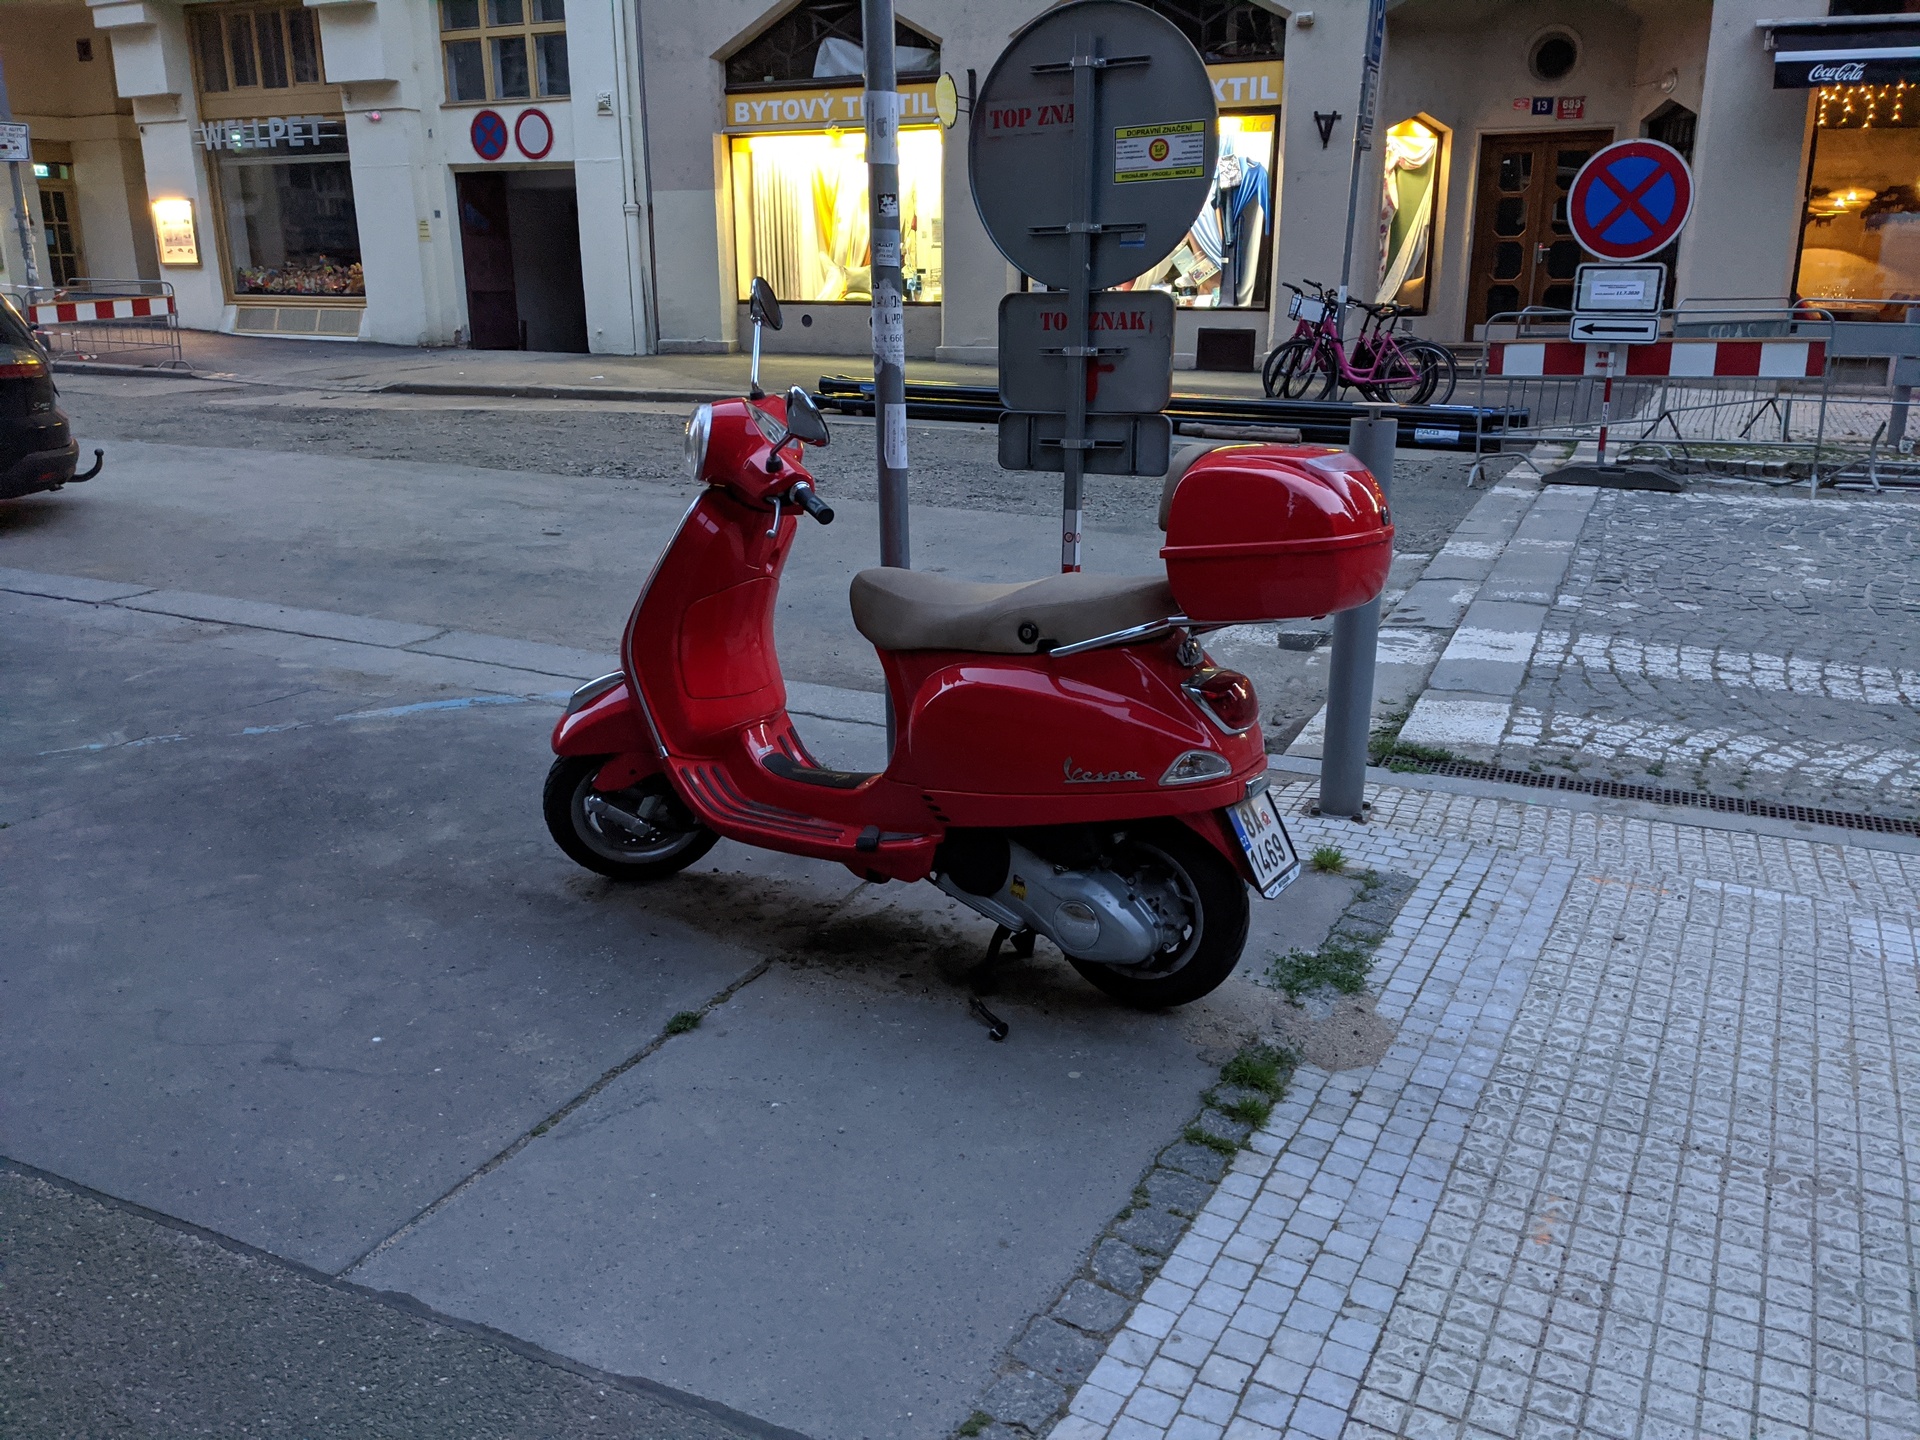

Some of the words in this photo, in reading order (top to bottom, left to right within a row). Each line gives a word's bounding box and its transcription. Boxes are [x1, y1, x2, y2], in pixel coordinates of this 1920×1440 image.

[1808, 62, 1868, 82] Coca-Cola
[1211, 75, 1278, 102] XTIL
[734, 92, 834, 123] BYTOVÝ
[842, 92, 937, 119] TTIL
[989, 107, 1032, 129] TOP
[1038, 103, 1074, 126] ZNA
[1537, 101, 1548, 111] 13
[200, 114, 324, 151] WELLPET
[1126, 127, 1162, 137] DOPRAVNÍ
[1162, 123, 1193, 134] ZNAČENÍ
[1040, 311, 1068, 331] TO
[1088, 311, 1146, 331] ZNAK
[1063, 756, 1146, 784] Vespa
[1239, 803, 1265, 839] 8A
[1250, 833, 1286, 879] 1469
